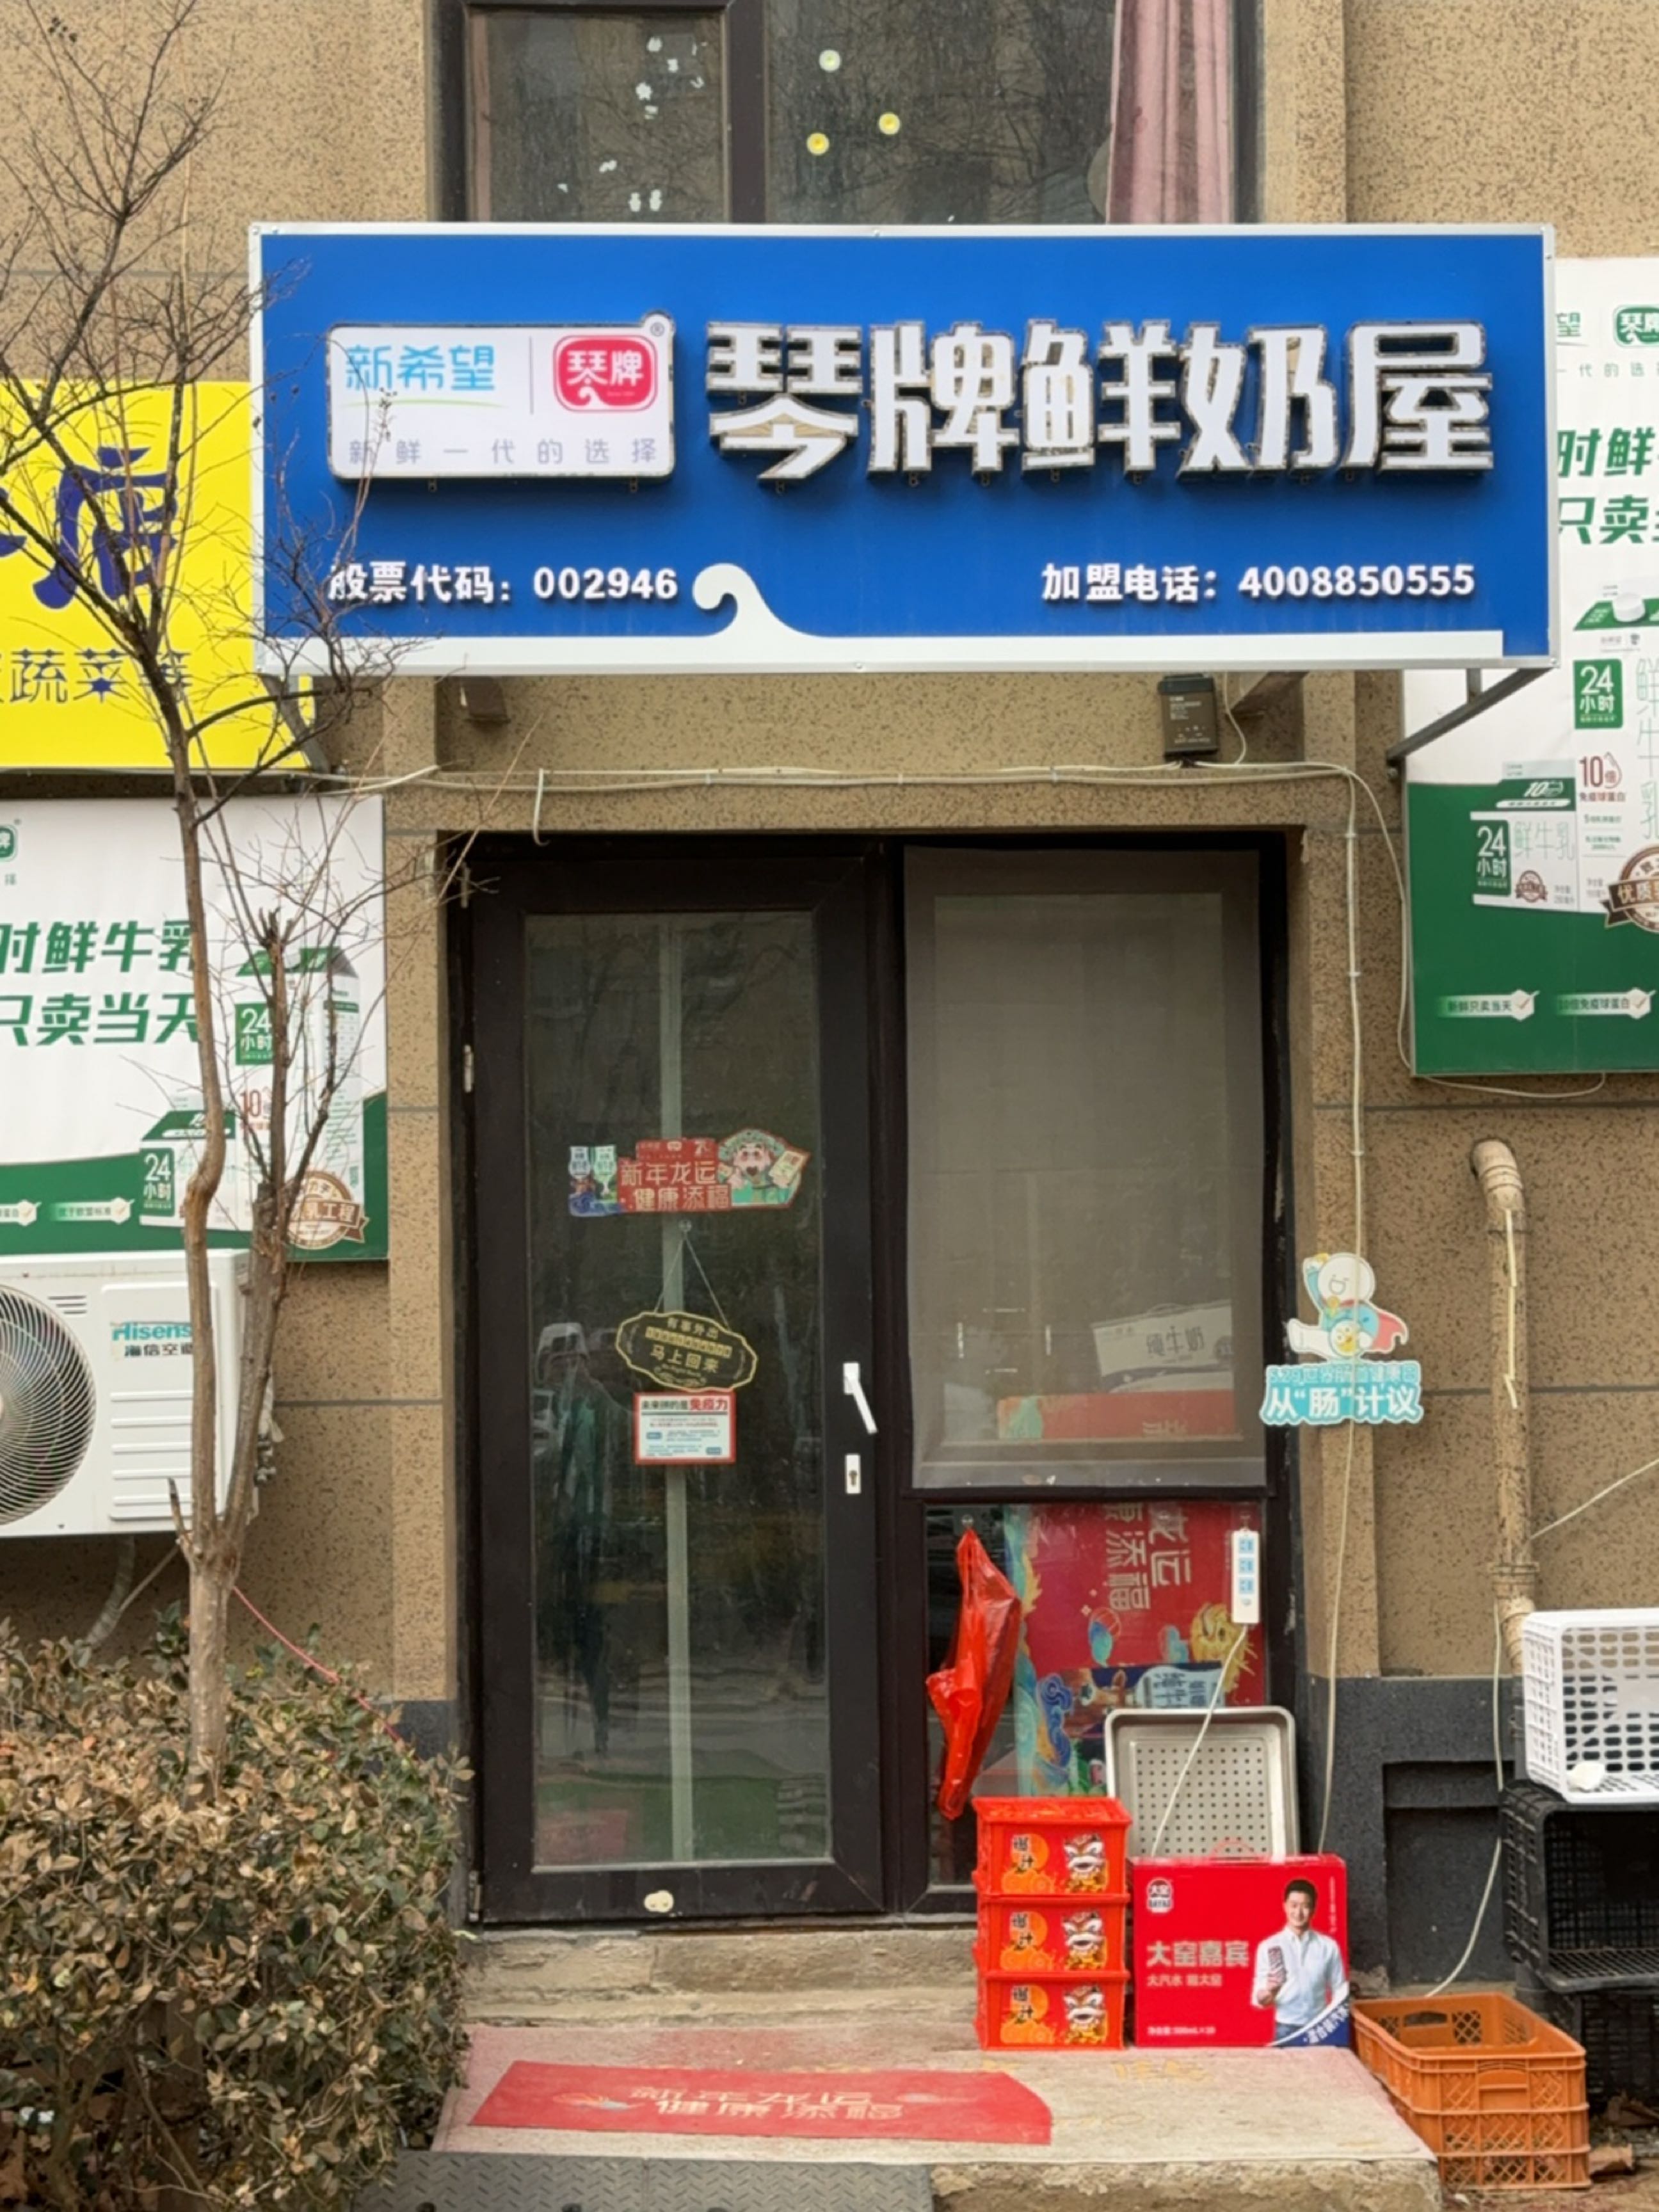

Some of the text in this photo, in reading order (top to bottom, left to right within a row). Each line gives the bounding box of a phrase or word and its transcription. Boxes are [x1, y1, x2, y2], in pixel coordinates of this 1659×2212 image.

[344, 344, 495, 392] 新希望
[566, 349, 644, 387] 琴牌
[705, 320, 1495, 481] 琴牌鲜奶屋
[348, 438, 658, 465] 新鲜一代的选择
[1558, 495, 1659, 545] 只卖
[1580, 666, 1614, 694] 24
[1580, 695, 1615, 714] 小时
[1477, 826, 1506, 856] 24
[1477, 858, 1507, 878] 小时
[241, 1007, 272, 1034] 24
[144, 1153, 172, 1182] 24
[621, 1160, 717, 1186] 新年龙运
[143, 1183, 172, 1201] 小时
[634, 1184, 730, 1212] 健康添福
[113, 1322, 192, 1342] Hisens
[650, 1344, 719, 1374] 马上回来
[1146, 1939, 1249, 1968] 大窑嘉宾
